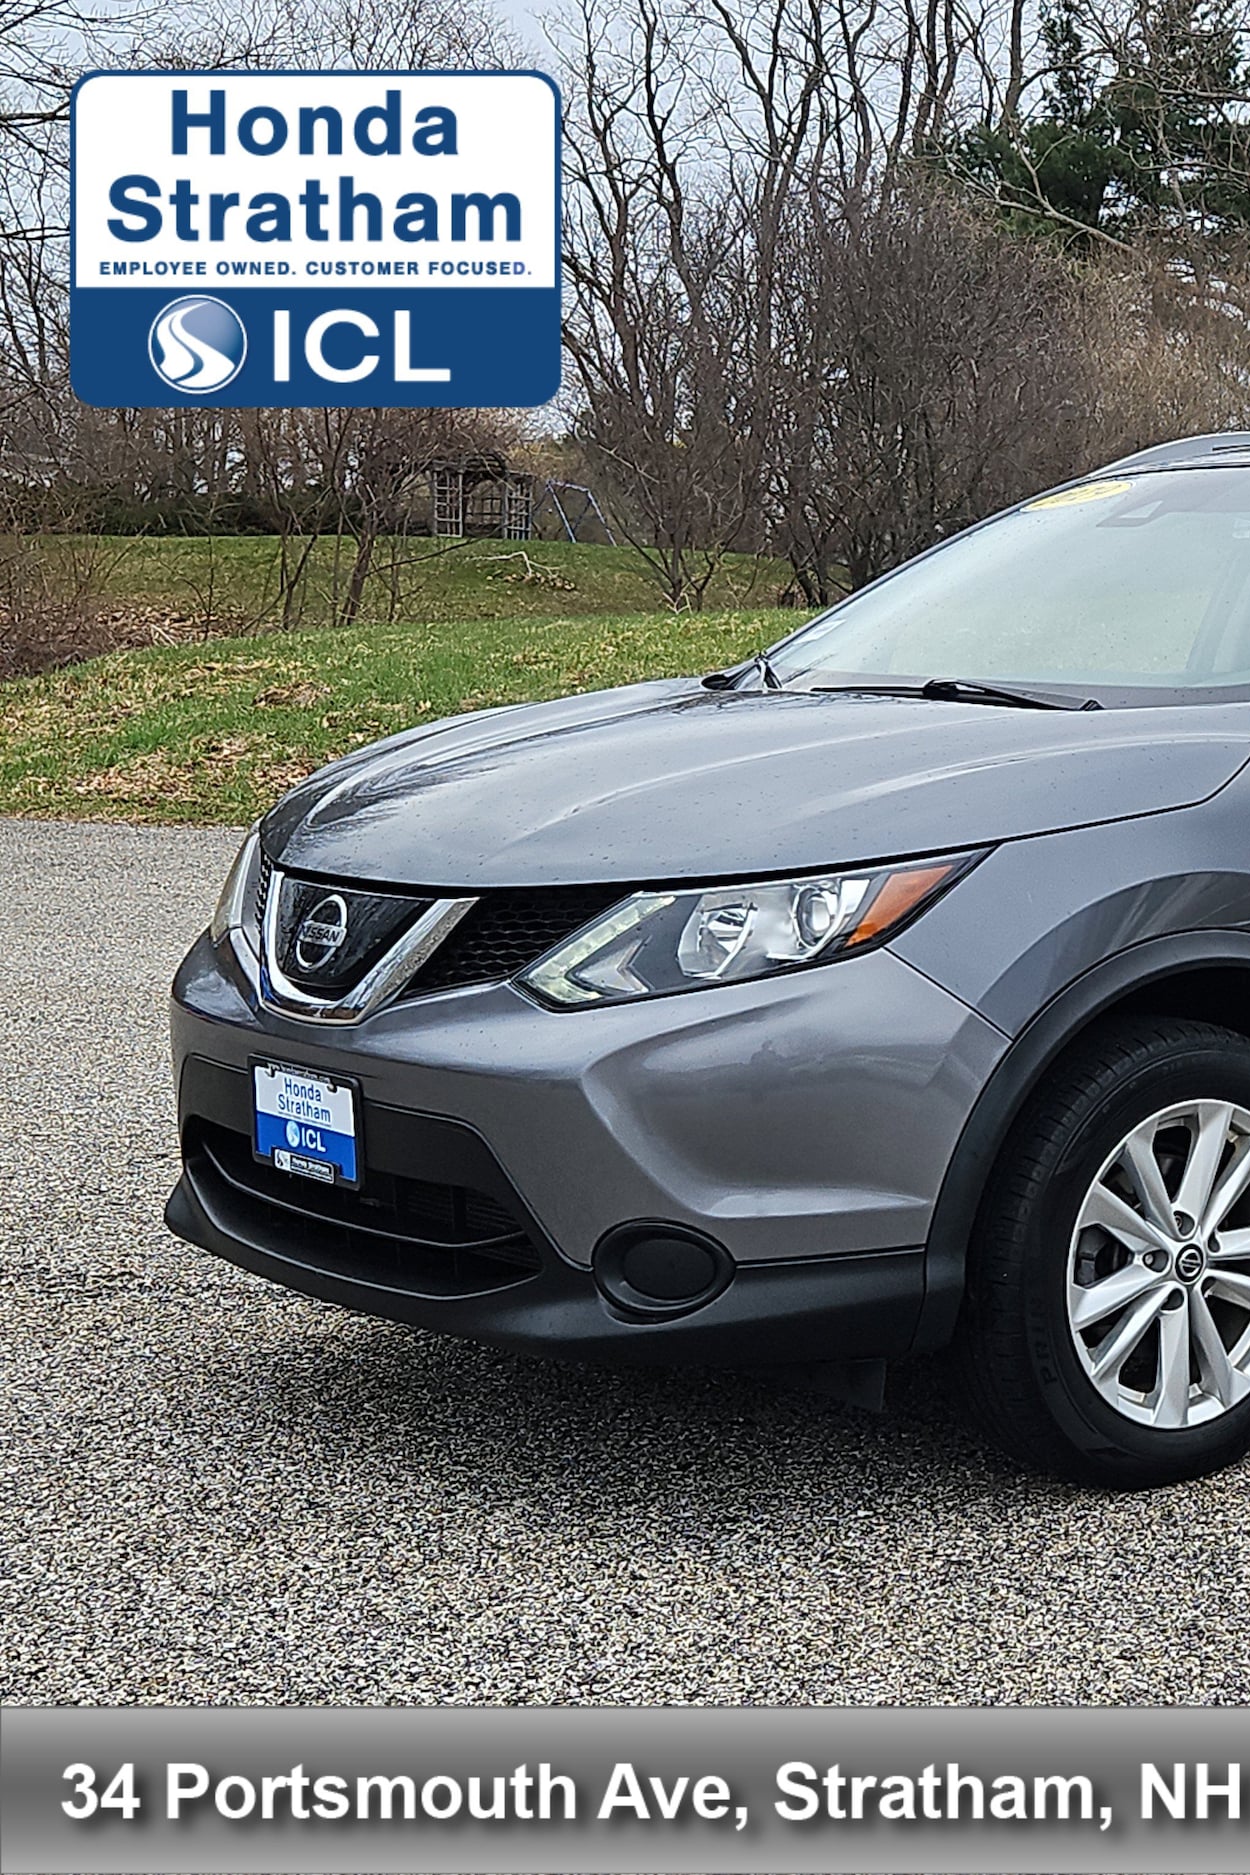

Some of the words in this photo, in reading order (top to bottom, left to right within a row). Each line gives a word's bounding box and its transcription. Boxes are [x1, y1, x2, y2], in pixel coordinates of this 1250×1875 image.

[300, 923, 341, 942] NISSAN
[284, 1077, 322, 1103] Honda
[278, 1094, 331, 1123] Stratham
[301, 1127, 327, 1152] ICL
